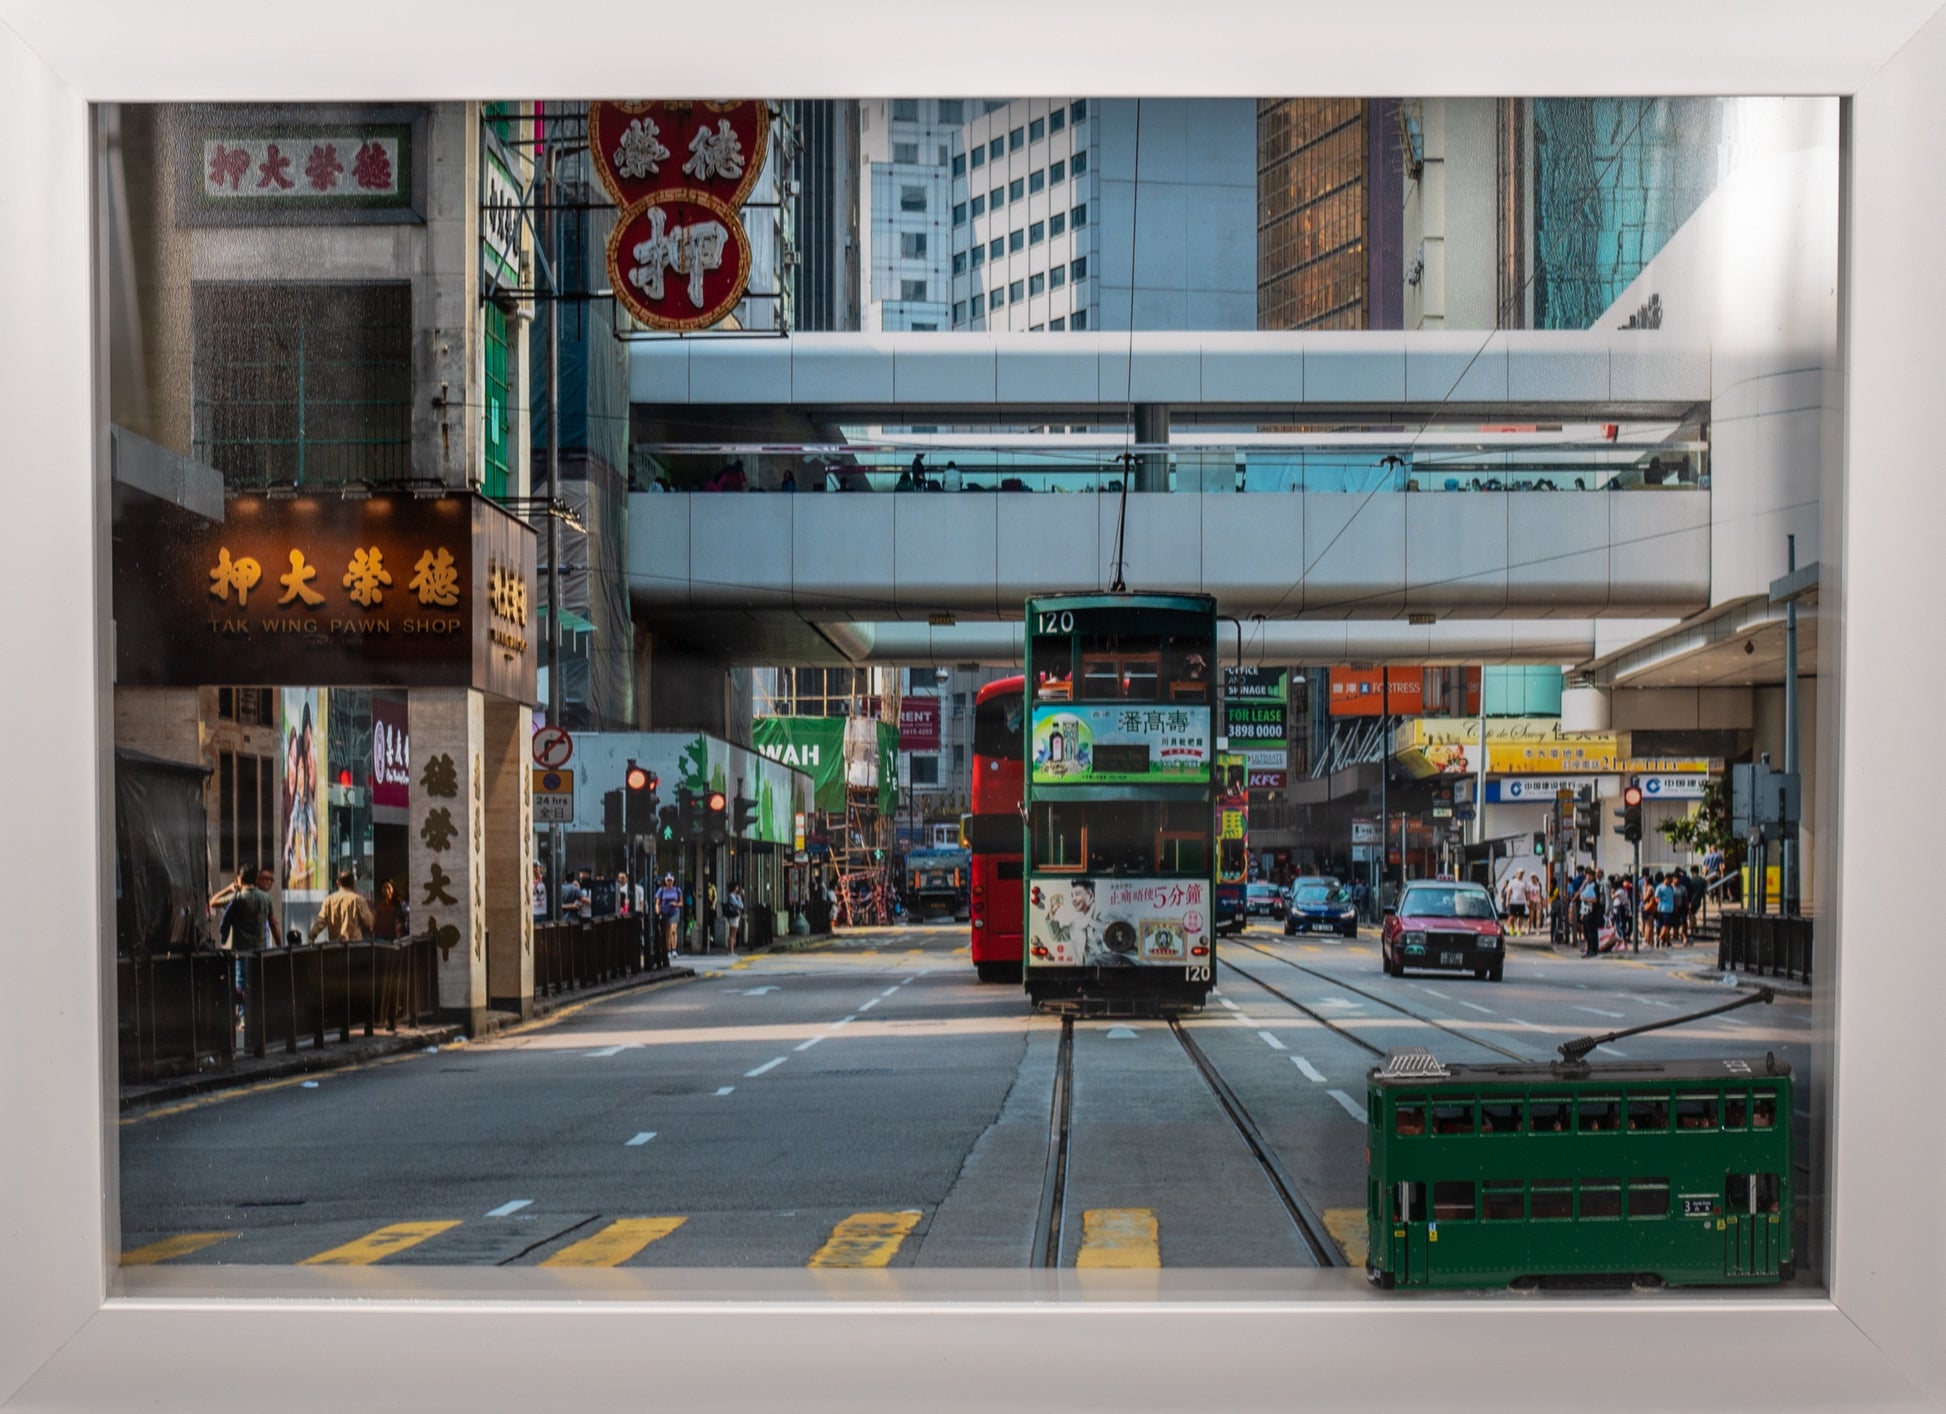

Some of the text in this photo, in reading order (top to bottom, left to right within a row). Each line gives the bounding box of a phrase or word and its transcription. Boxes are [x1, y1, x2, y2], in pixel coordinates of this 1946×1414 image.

[628, 206, 728, 309] 押
[209, 619, 461, 633] TAK WING PAWN SHOP
[1038, 611, 1074, 634] 120
[1229, 709, 1282, 721] FOR LEASE
[1228, 725, 1282, 737] 3898 0000
[758, 744, 820, 766] WAH
[1249, 774, 1281, 786] KFC
[536, 796, 567, 805] 24 hrs
[540, 807, 564, 819] 全日
[1185, 967, 1211, 982] 120
